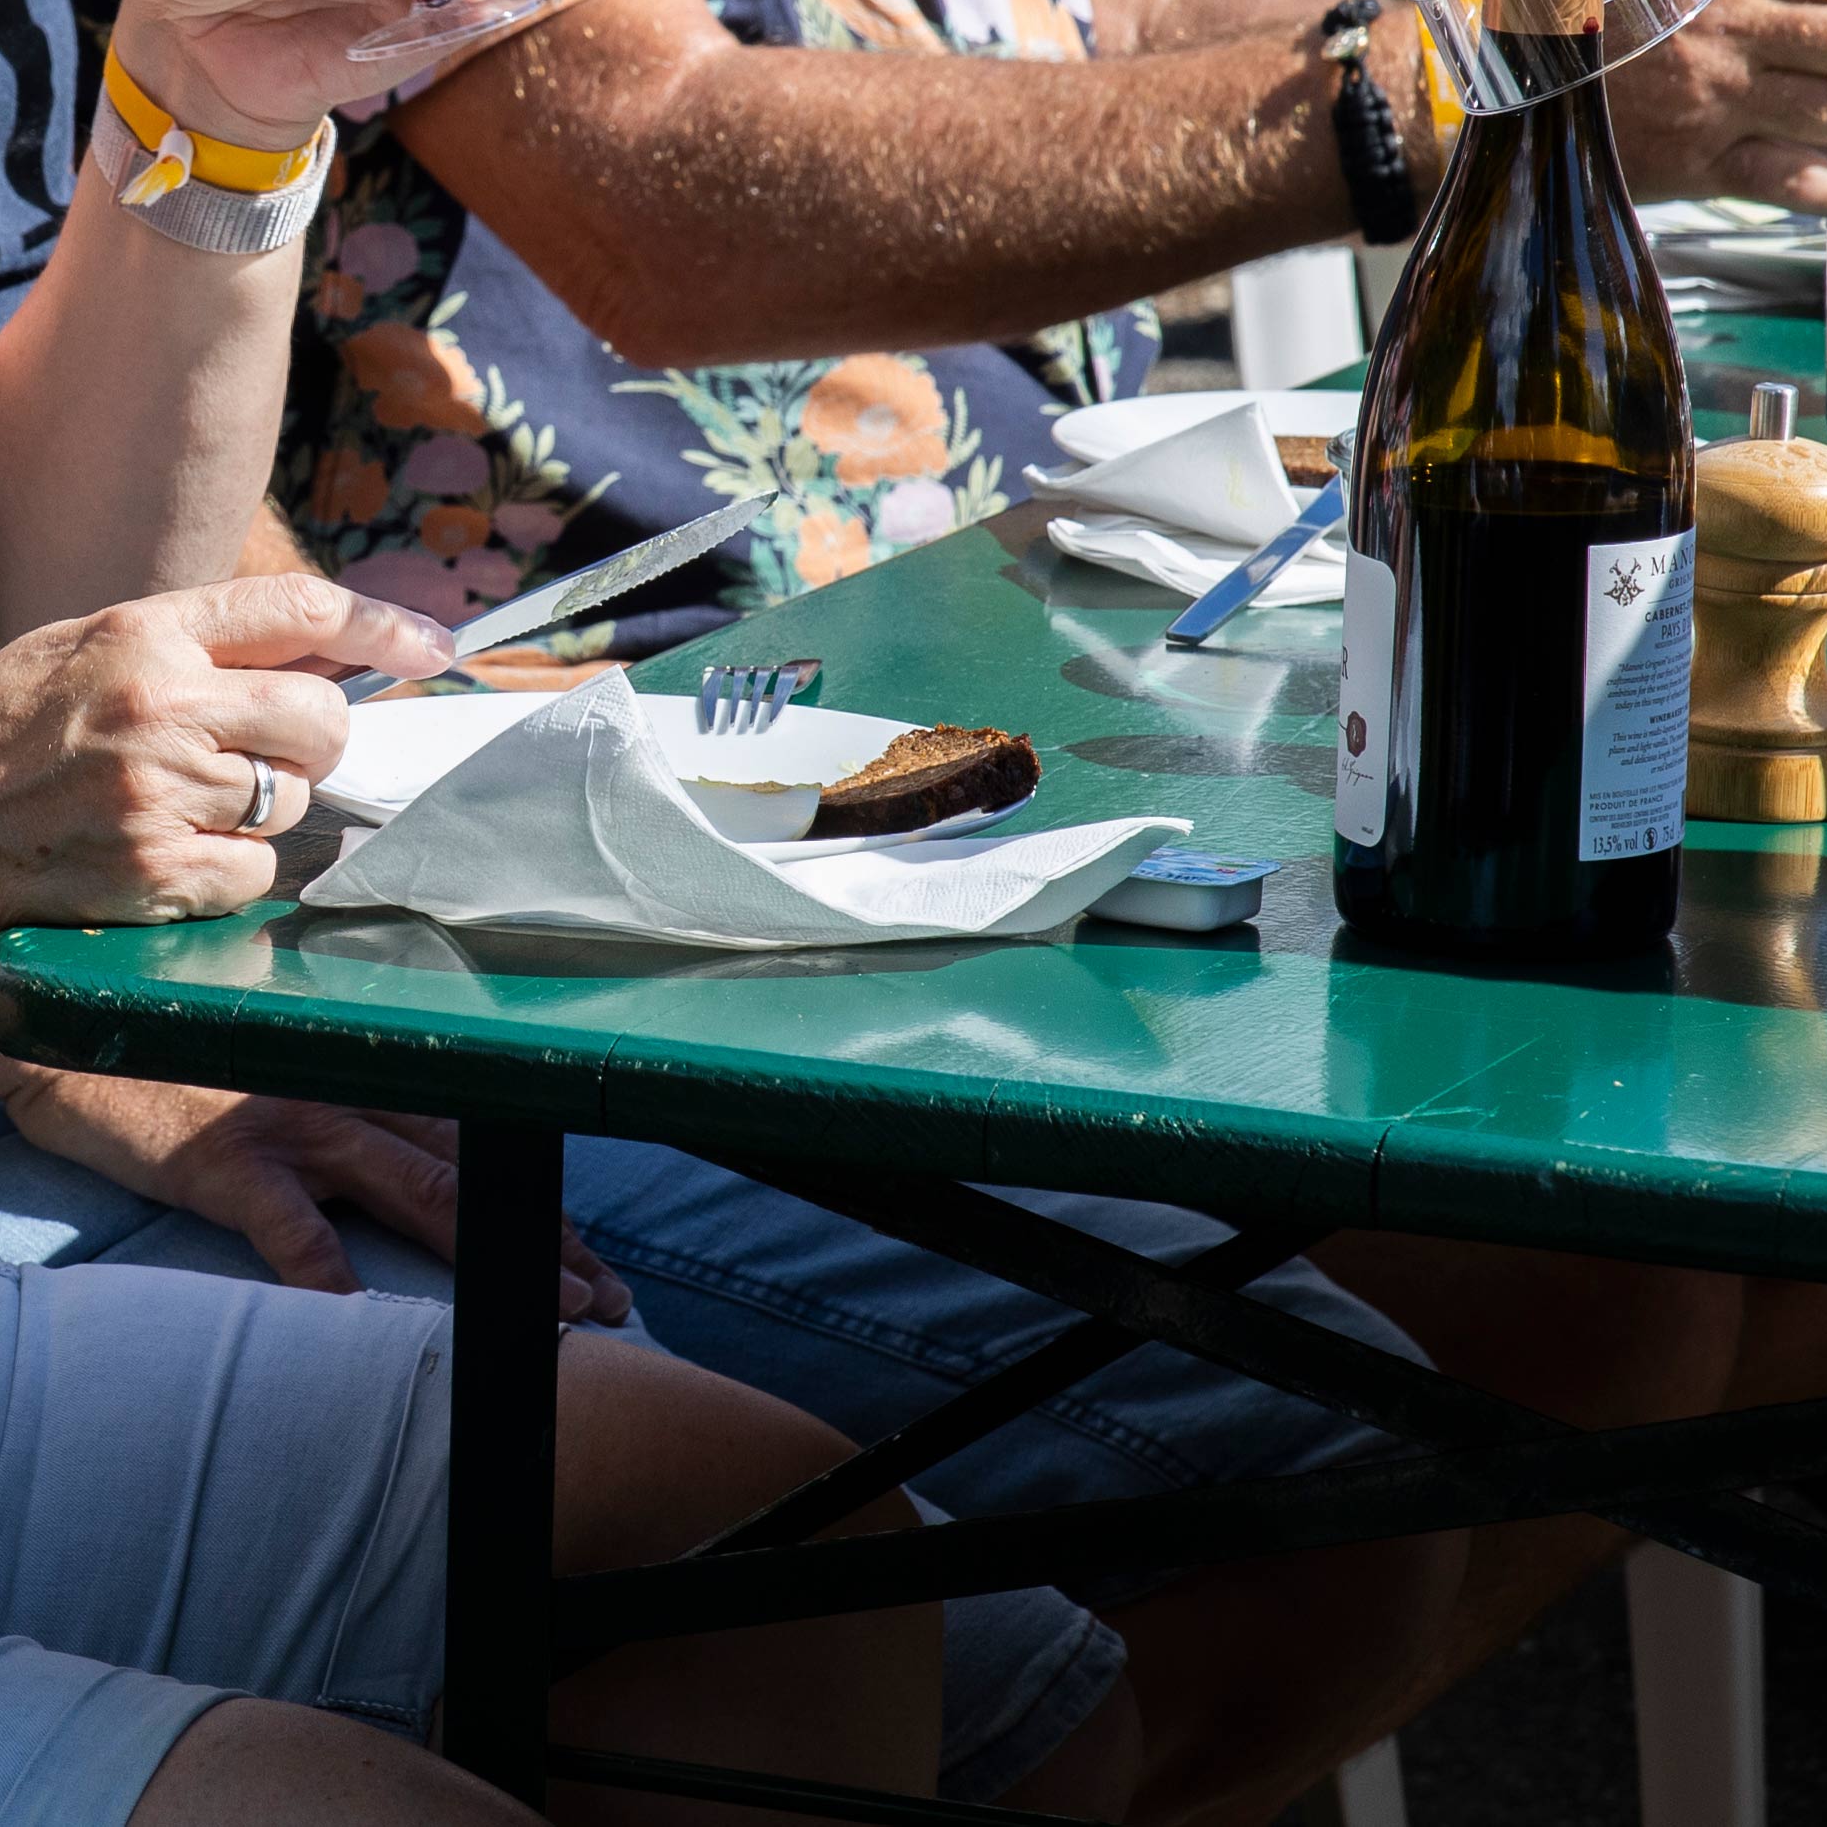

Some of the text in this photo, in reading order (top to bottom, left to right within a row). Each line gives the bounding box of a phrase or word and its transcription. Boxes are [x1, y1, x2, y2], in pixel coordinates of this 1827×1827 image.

[1661, 620, 1681, 640] PAYS
[1589, 794, 1663, 811] PRODUIT DE FRANCE
[1593, 832, 1622, 856] 13,5%
[1624, 830, 1638, 851] vol
